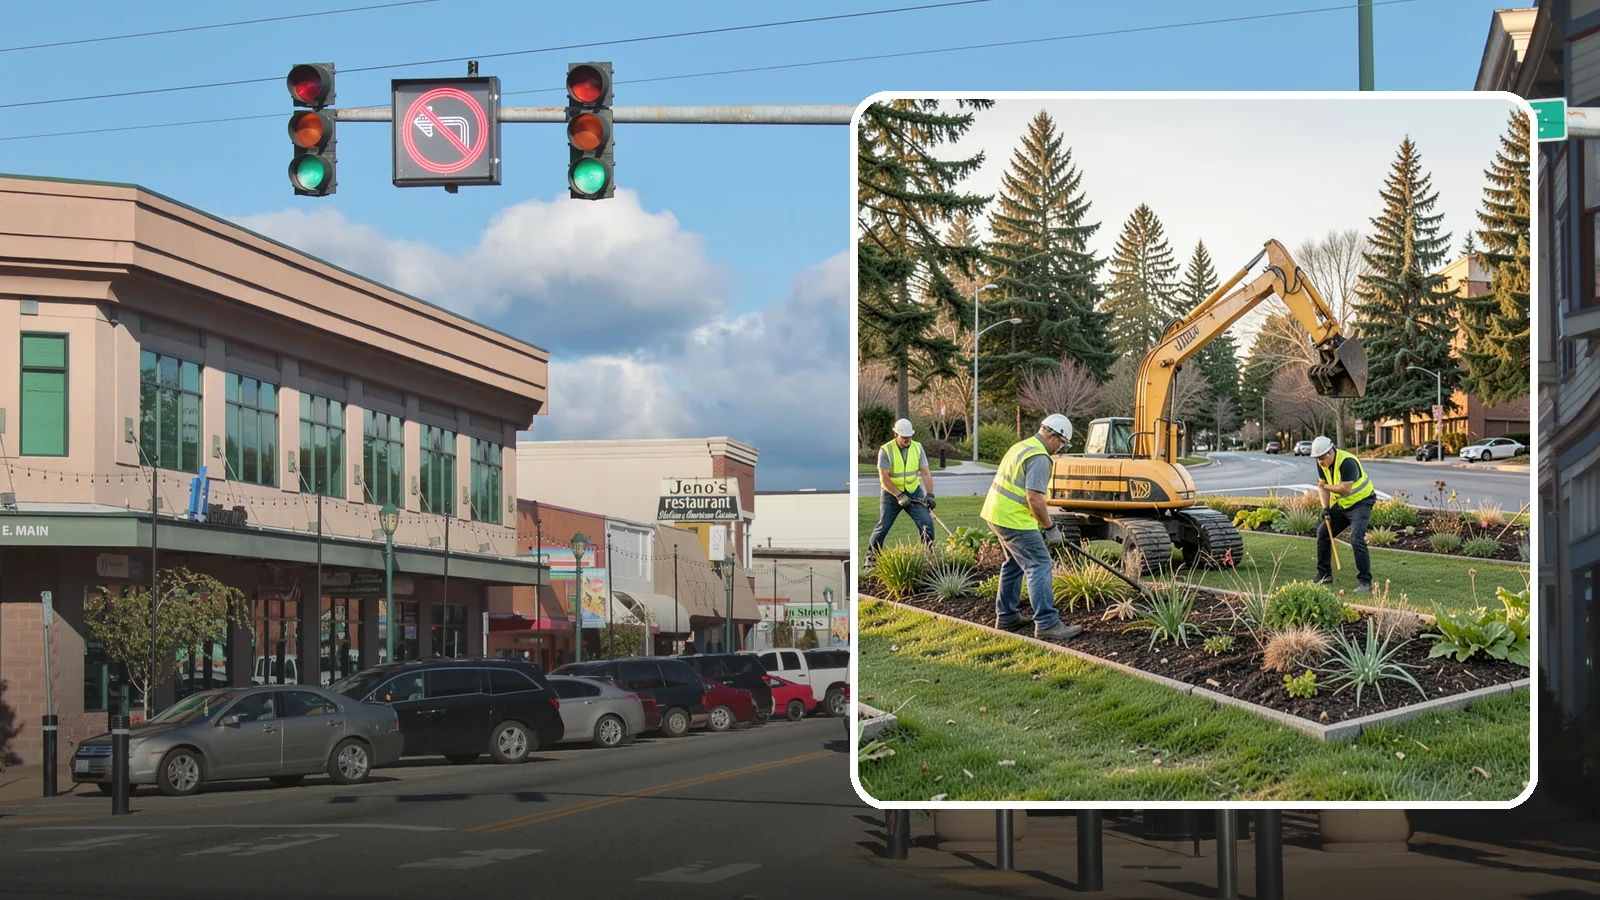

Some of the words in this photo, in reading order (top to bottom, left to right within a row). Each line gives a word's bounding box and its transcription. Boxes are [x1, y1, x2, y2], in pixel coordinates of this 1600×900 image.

[669, 479, 727, 495] Jeno's
[665, 496, 731, 509] restaurant
[686, 510, 714, 520] American
[714, 509, 737, 519] Cuisine
[2, 525, 13, 536] E.
[15, 525, 49, 536] MAIN
[797, 607, 828, 617] Street
